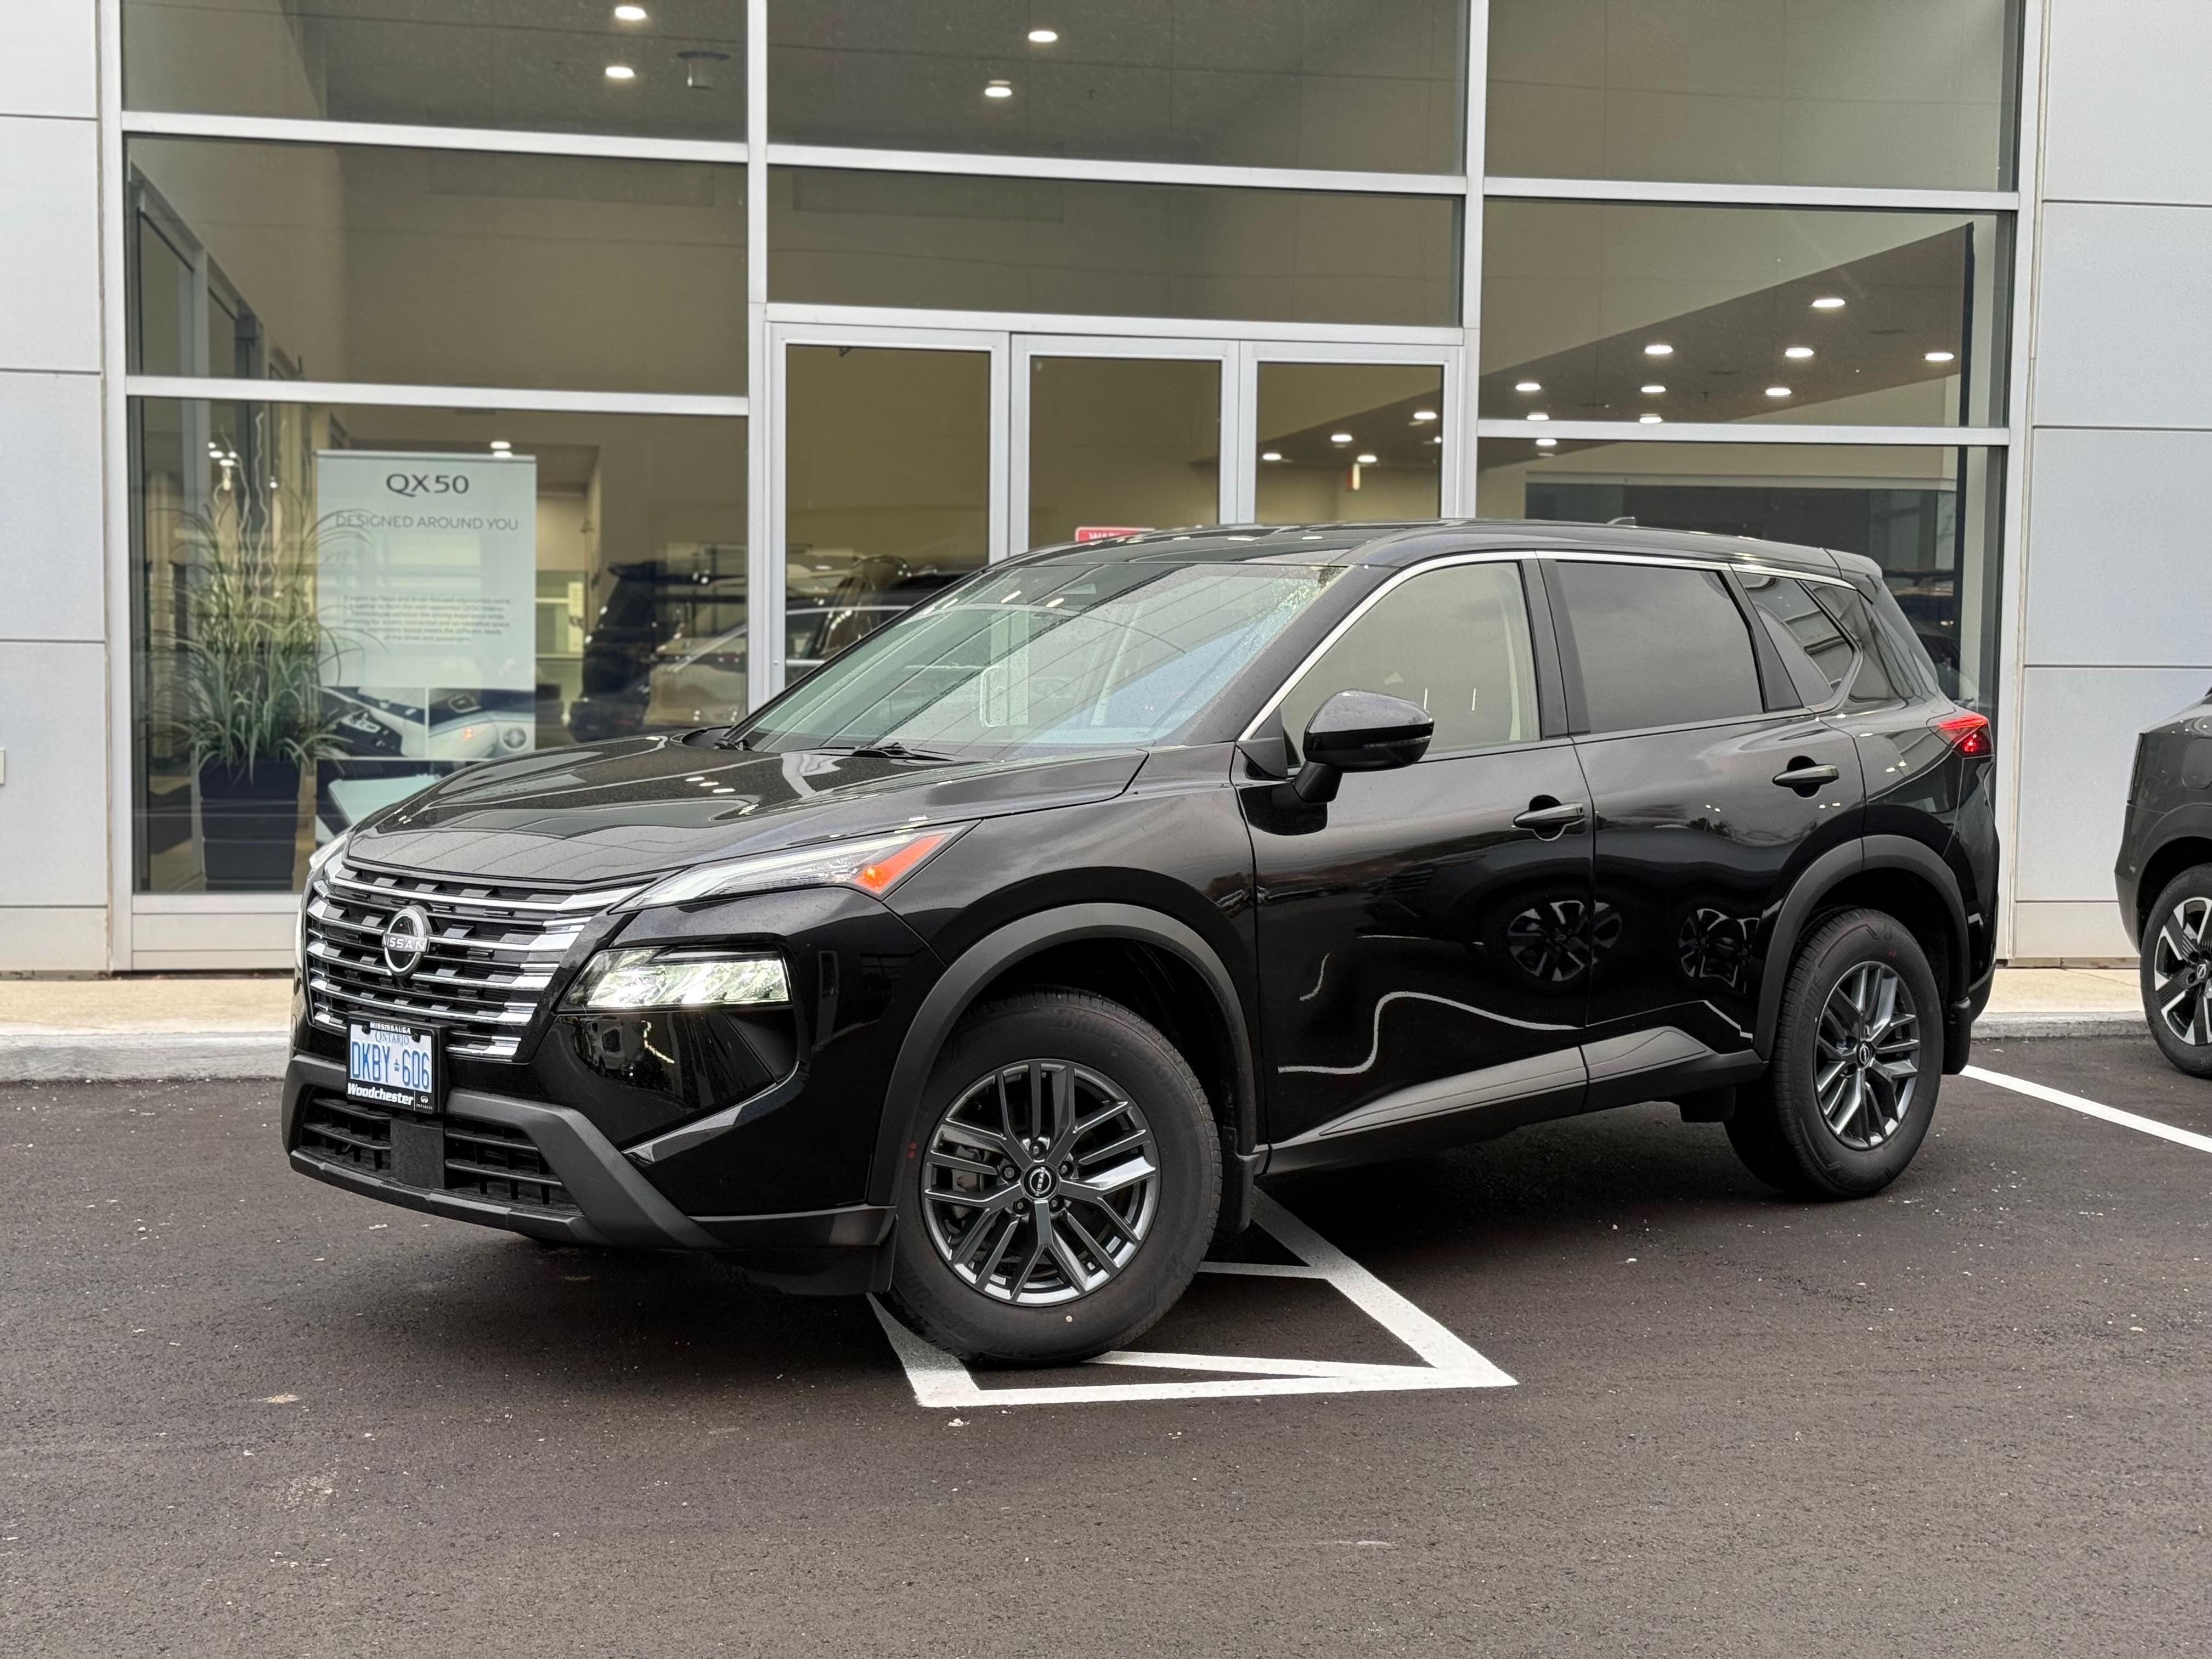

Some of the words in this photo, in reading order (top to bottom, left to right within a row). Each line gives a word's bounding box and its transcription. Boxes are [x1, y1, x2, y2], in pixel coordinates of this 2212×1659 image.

[386, 473, 470, 497] QX50
[335, 515, 414, 528] DESIGNED
[416, 516, 483, 529] AROUND
[487, 518, 519, 531] YOU
[382, 935, 425, 950] NISSAN
[370, 1022, 411, 1035] MISSISSAUGA
[375, 1031, 409, 1047] ONTARIO
[352, 1041, 391, 1083] DKBY
[402, 1048, 430, 1090] 606
[347, 1082, 414, 1106] Woodchester
